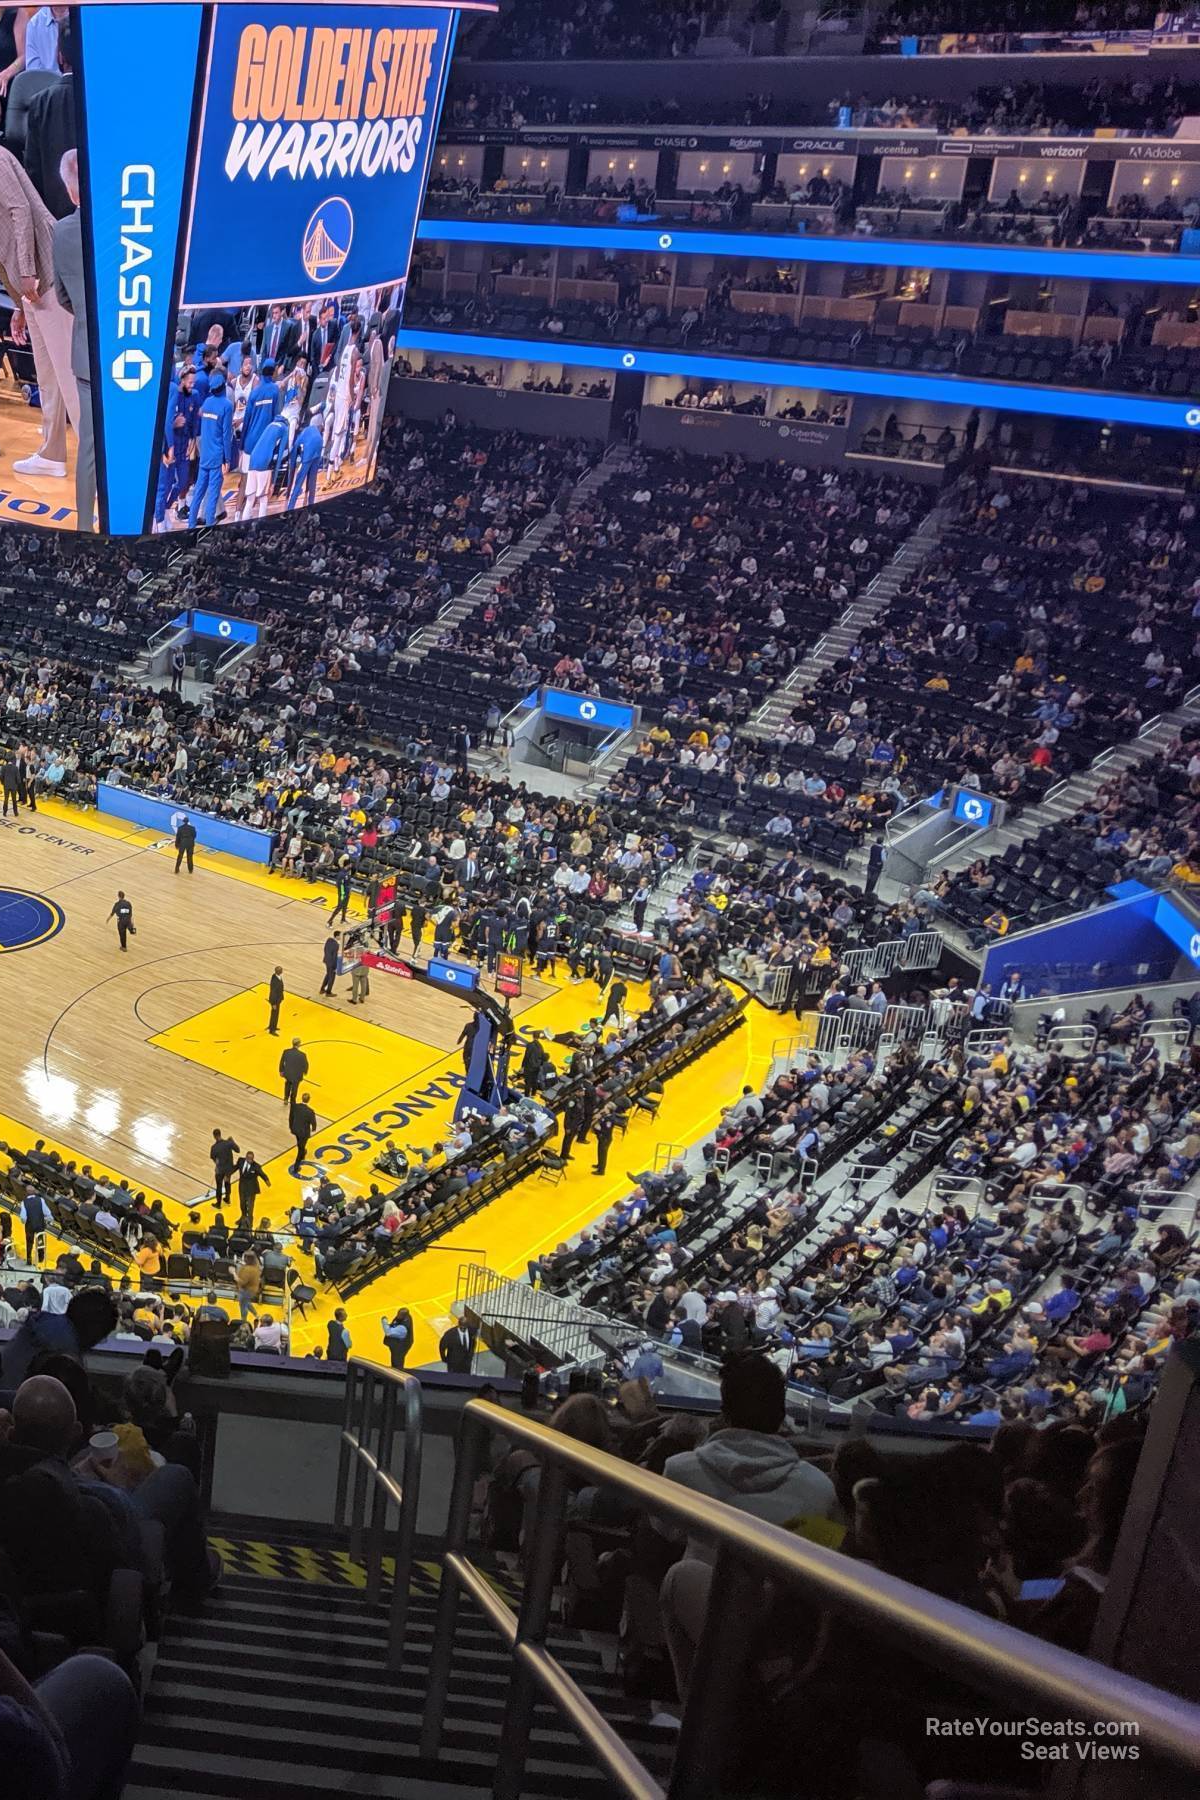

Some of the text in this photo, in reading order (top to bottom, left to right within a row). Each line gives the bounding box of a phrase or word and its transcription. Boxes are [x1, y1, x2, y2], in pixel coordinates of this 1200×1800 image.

[231, 24, 439, 122] GOLDEN STATE
[523, 134, 569, 145] Google Cloud
[654, 138, 686, 147] CHASE
[729, 138, 762, 148] Rakuten
[793, 140, 845, 150] ORACLE
[224, 117, 424, 182] WARRIORS
[873, 144, 919, 154] accenture
[1040, 145, 1085, 157] verizon
[1144, 147, 1181, 158] Adobe
[117, 164, 155, 340] CHASE
[35, 832, 96, 856] CENTER
[288, 1070, 467, 1181] RANCISCO
